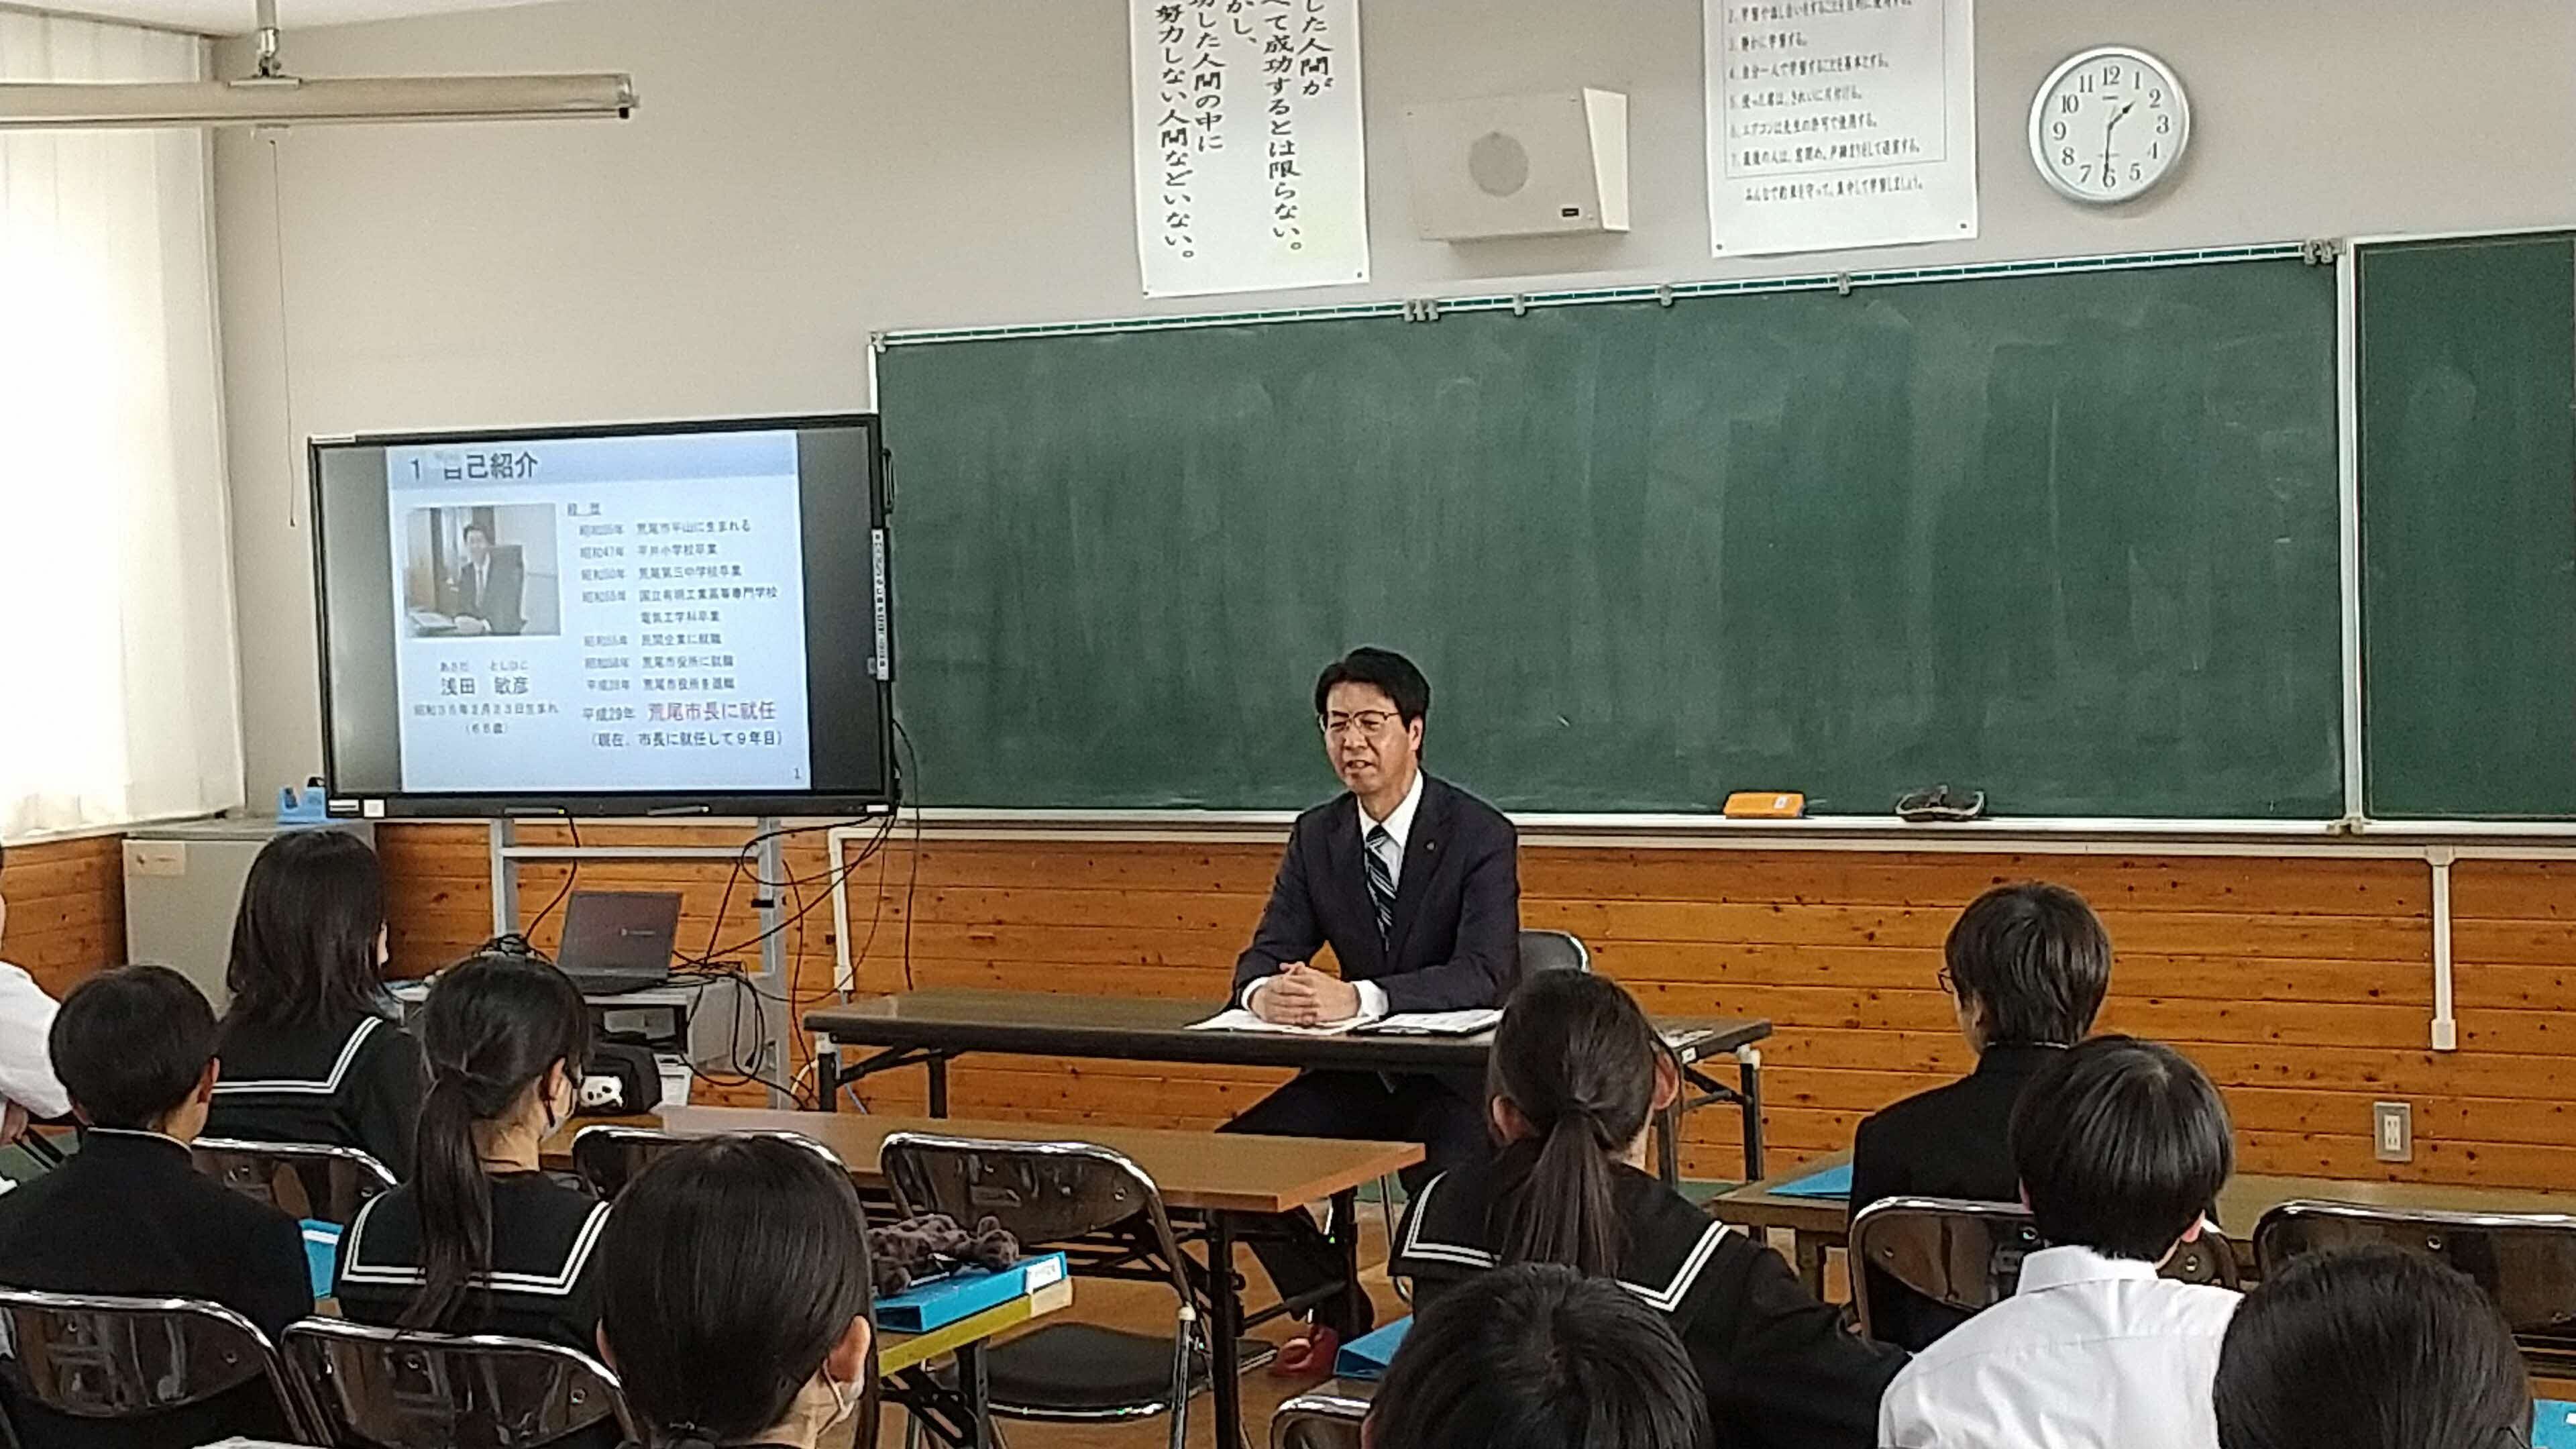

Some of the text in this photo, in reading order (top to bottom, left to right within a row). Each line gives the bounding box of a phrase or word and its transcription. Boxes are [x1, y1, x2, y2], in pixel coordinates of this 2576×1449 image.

[2080, 74, 2094, 93] 11
[2102, 66, 2121, 85] 12
[2135, 71, 2140, 89] 1
[2061, 95, 2079, 113] 10
[2149, 89, 2161, 108] 2
[1155, 4, 1195, 258] 努力しない人間などいない。
[2053, 121, 2066, 141] 9
[2156, 115, 2169, 134] 3
[2061, 147, 2074, 166] 8
[2147, 142, 2157, 160] 4
[2080, 164, 2092, 182] 7
[2103, 167, 2116, 187] 6
[2129, 163, 2141, 180] 5
[411, 458, 420, 480] 1
[441, 676, 529, 696] 浅田 敏彦
[647, 701, 776, 722] 荒尾市長に就任
[794, 767, 800, 779] 1
